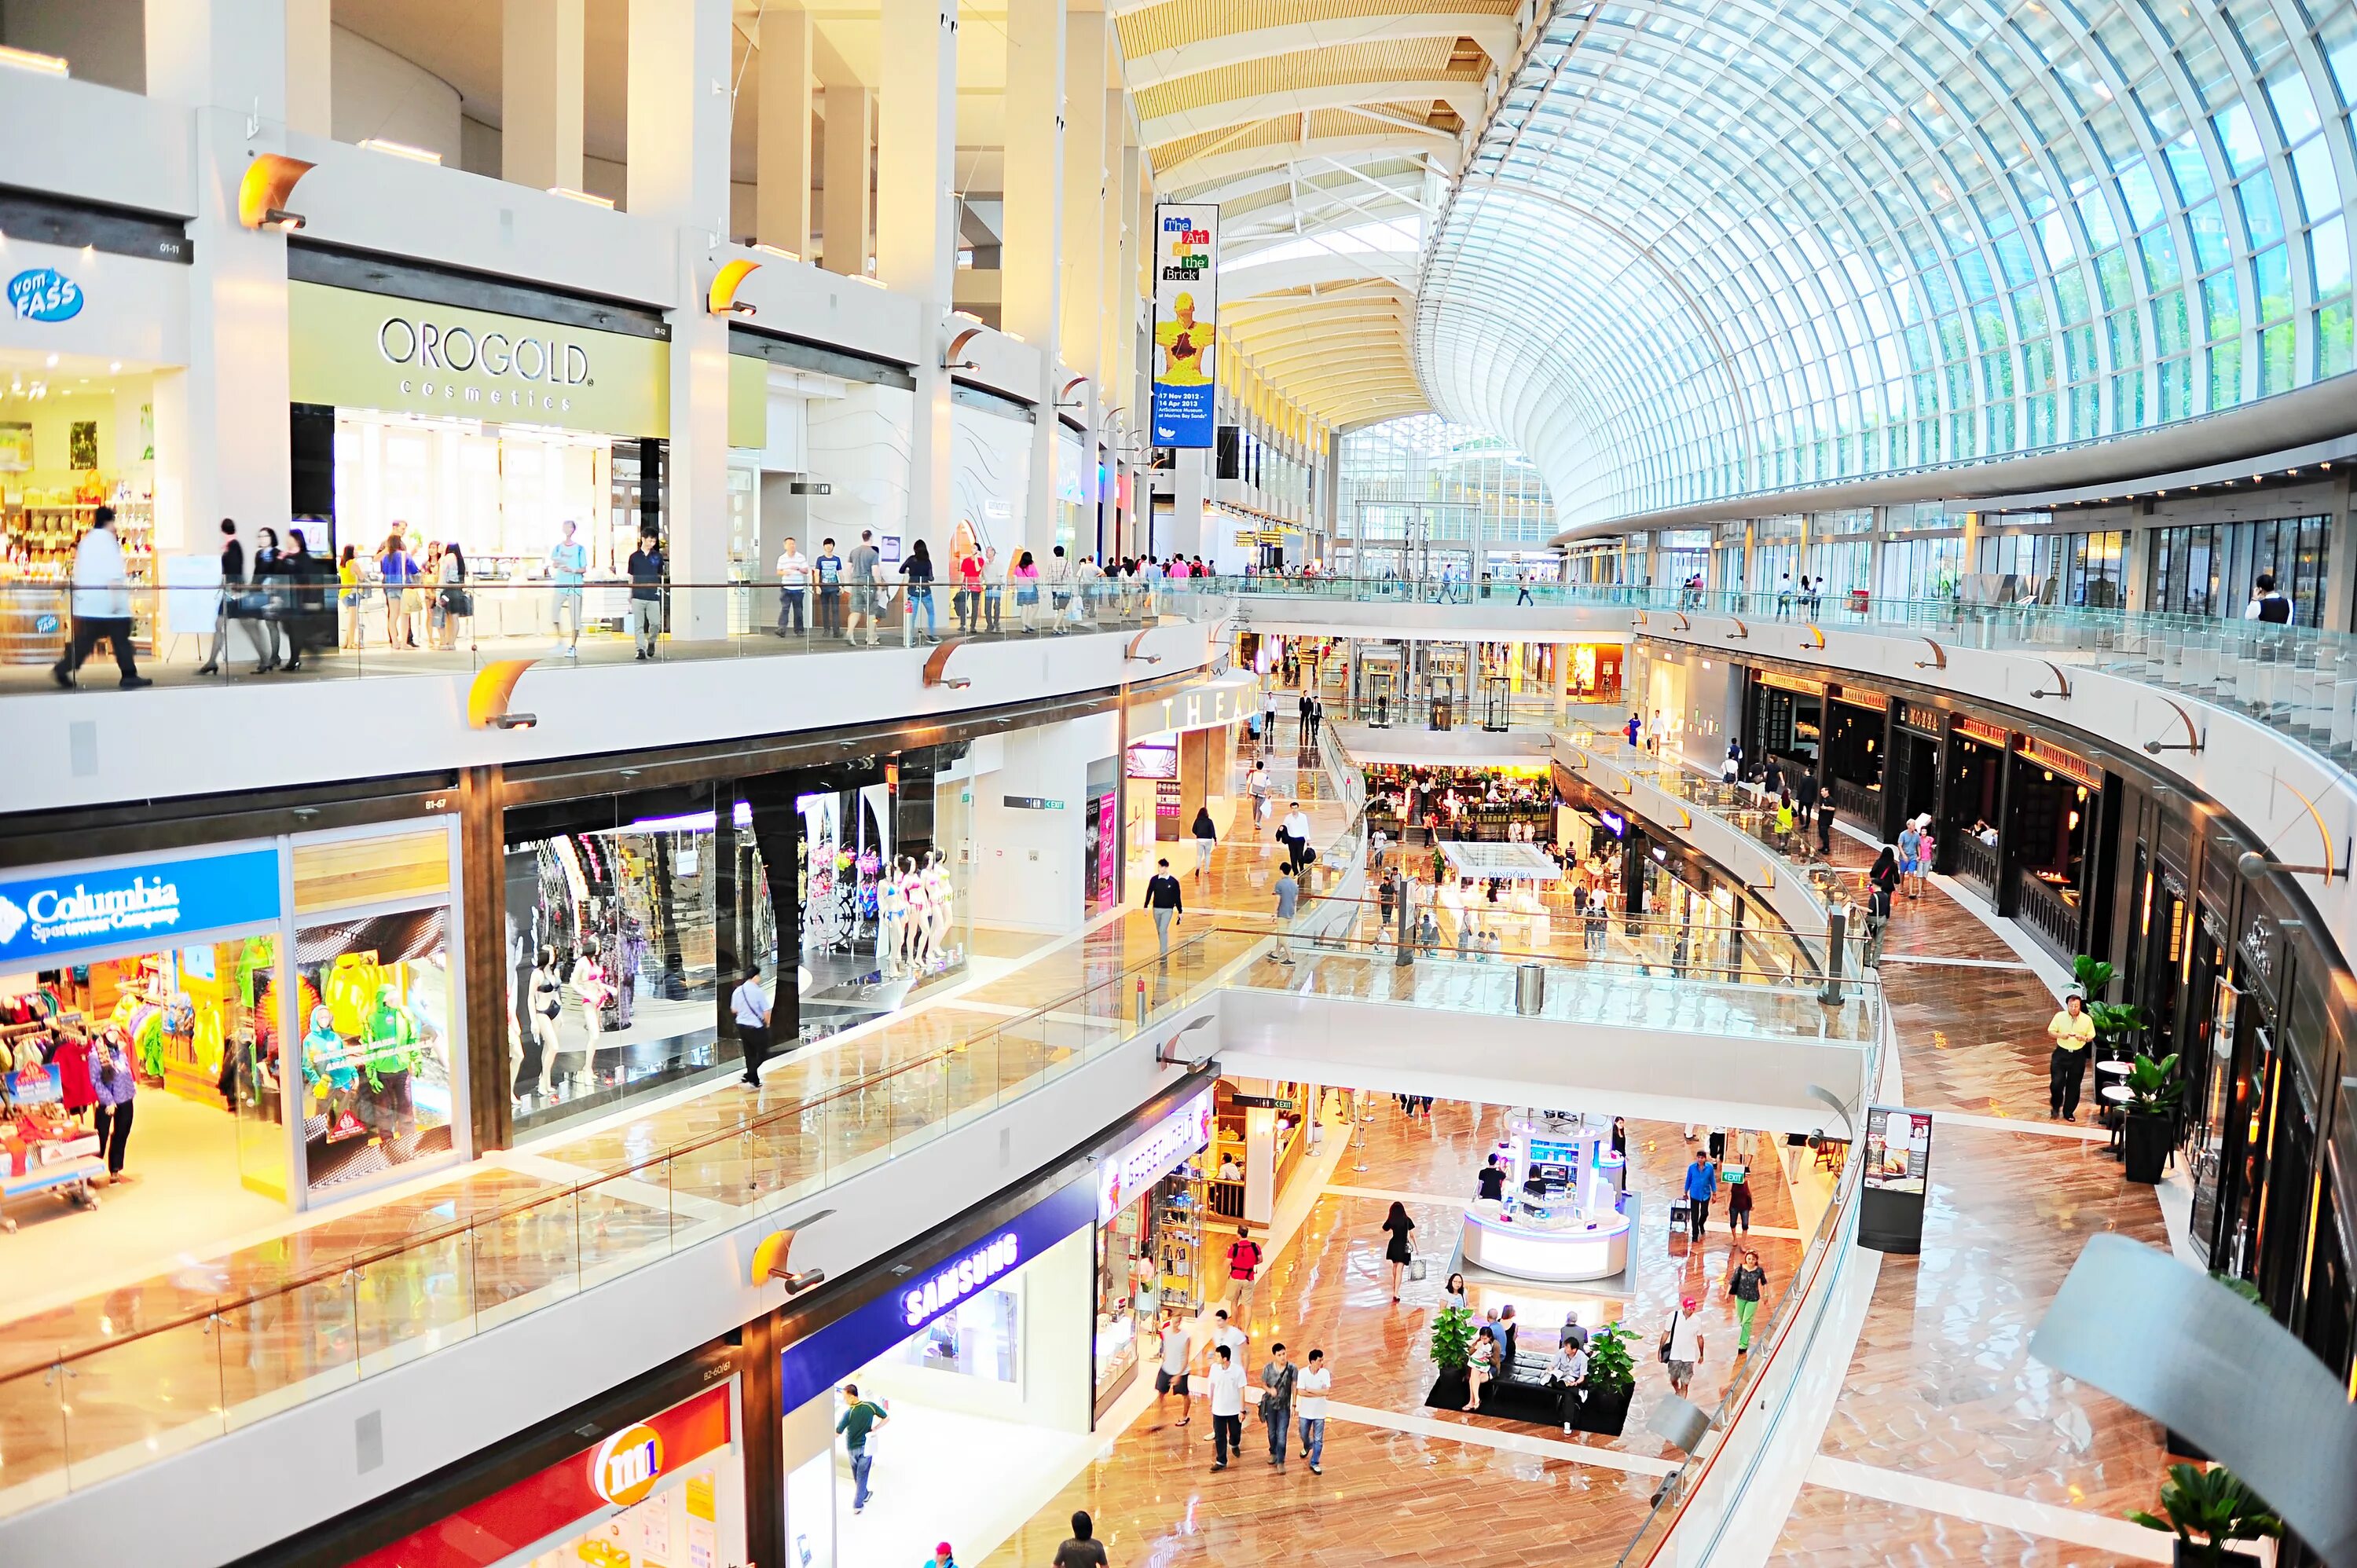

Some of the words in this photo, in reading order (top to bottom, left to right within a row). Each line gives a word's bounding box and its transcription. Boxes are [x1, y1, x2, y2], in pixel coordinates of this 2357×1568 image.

[1166, 220, 1189, 231] The
[1186, 233, 1205, 244] Art
[159, 243, 180, 255] 01-11
[1175, 244, 1187, 255] of
[1186, 257, 1204, 268] the
[1166, 269, 1196, 280] Brick
[13, 273, 46, 295] vom
[16, 280, 76, 321] FASS
[401, 379, 571, 411] cosmetics
[1909, 707, 1939, 732] MOZZA
[1488, 870, 1531, 879] PANDORA
[27, 876, 180, 923] Columbia
[1728, 1173, 1742, 1182] EXIT
[905, 1233, 1018, 1327] SAMSUNG
[703, 1361, 731, 1381] B2-60/61
